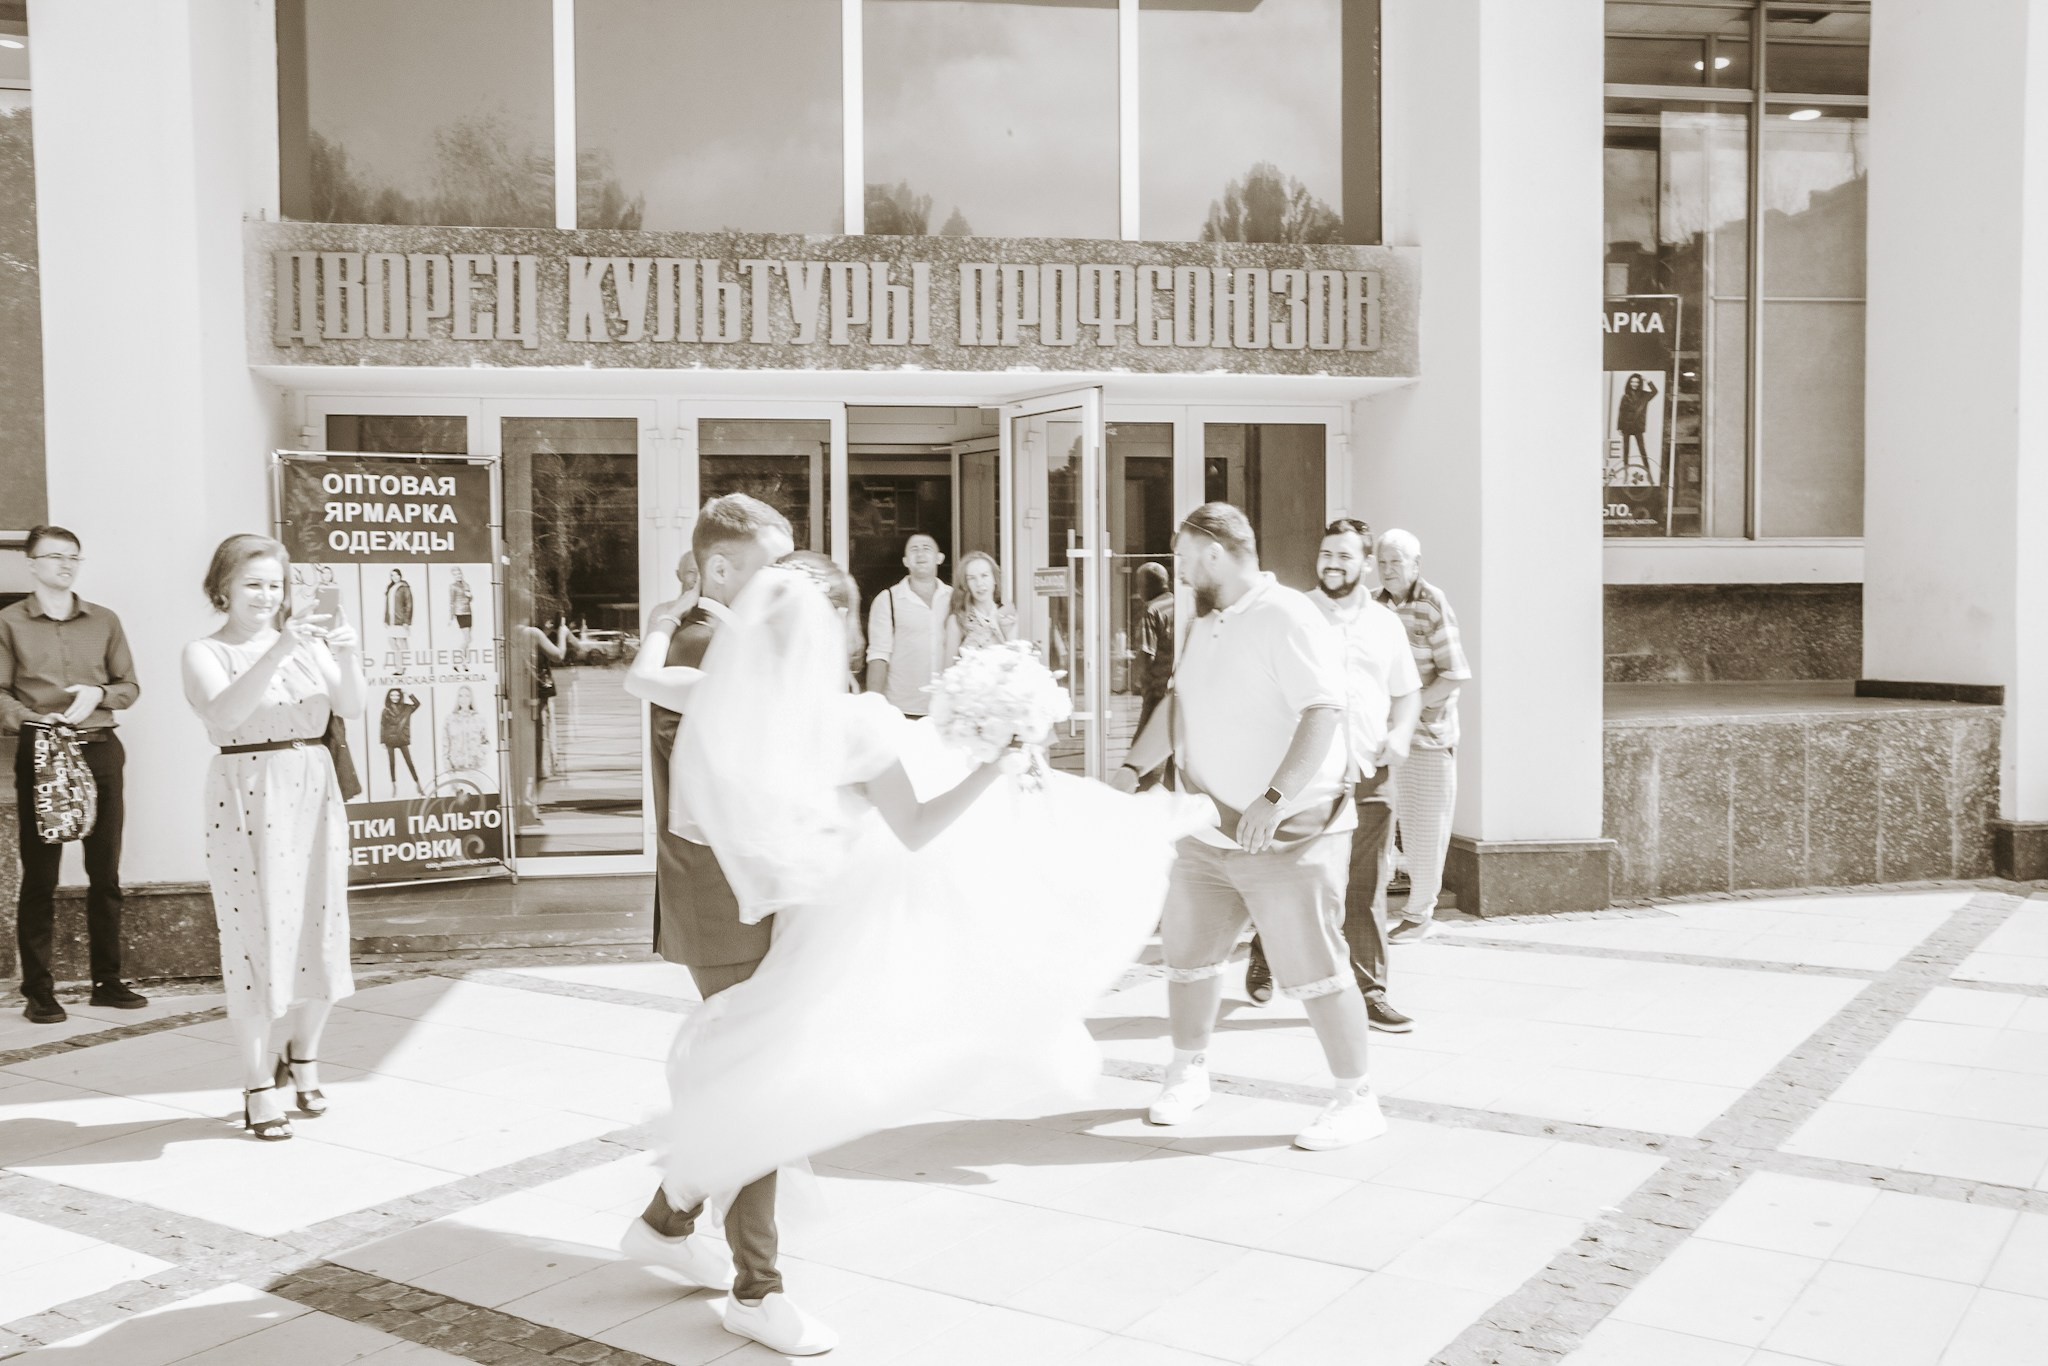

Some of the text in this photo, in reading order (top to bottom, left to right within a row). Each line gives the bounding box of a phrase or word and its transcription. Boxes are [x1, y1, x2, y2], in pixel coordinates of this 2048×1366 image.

[273, 250, 1382, 352] ДВОРЕЦ КУЛЬТУРЫ ПРОФСОЮЗОВ
[322, 473, 457, 496] ОПТОВАЯ
[324, 501, 458, 524] ЯРМАРКА
[328, 530, 455, 555] ОДЕЖДЫ
[383, 649, 494, 669] ДЕШЕВЛЕ
[439, 673, 488, 684] ОДЕЖДА
[348, 809, 502, 840] ТКИ ПАЛЬТО
